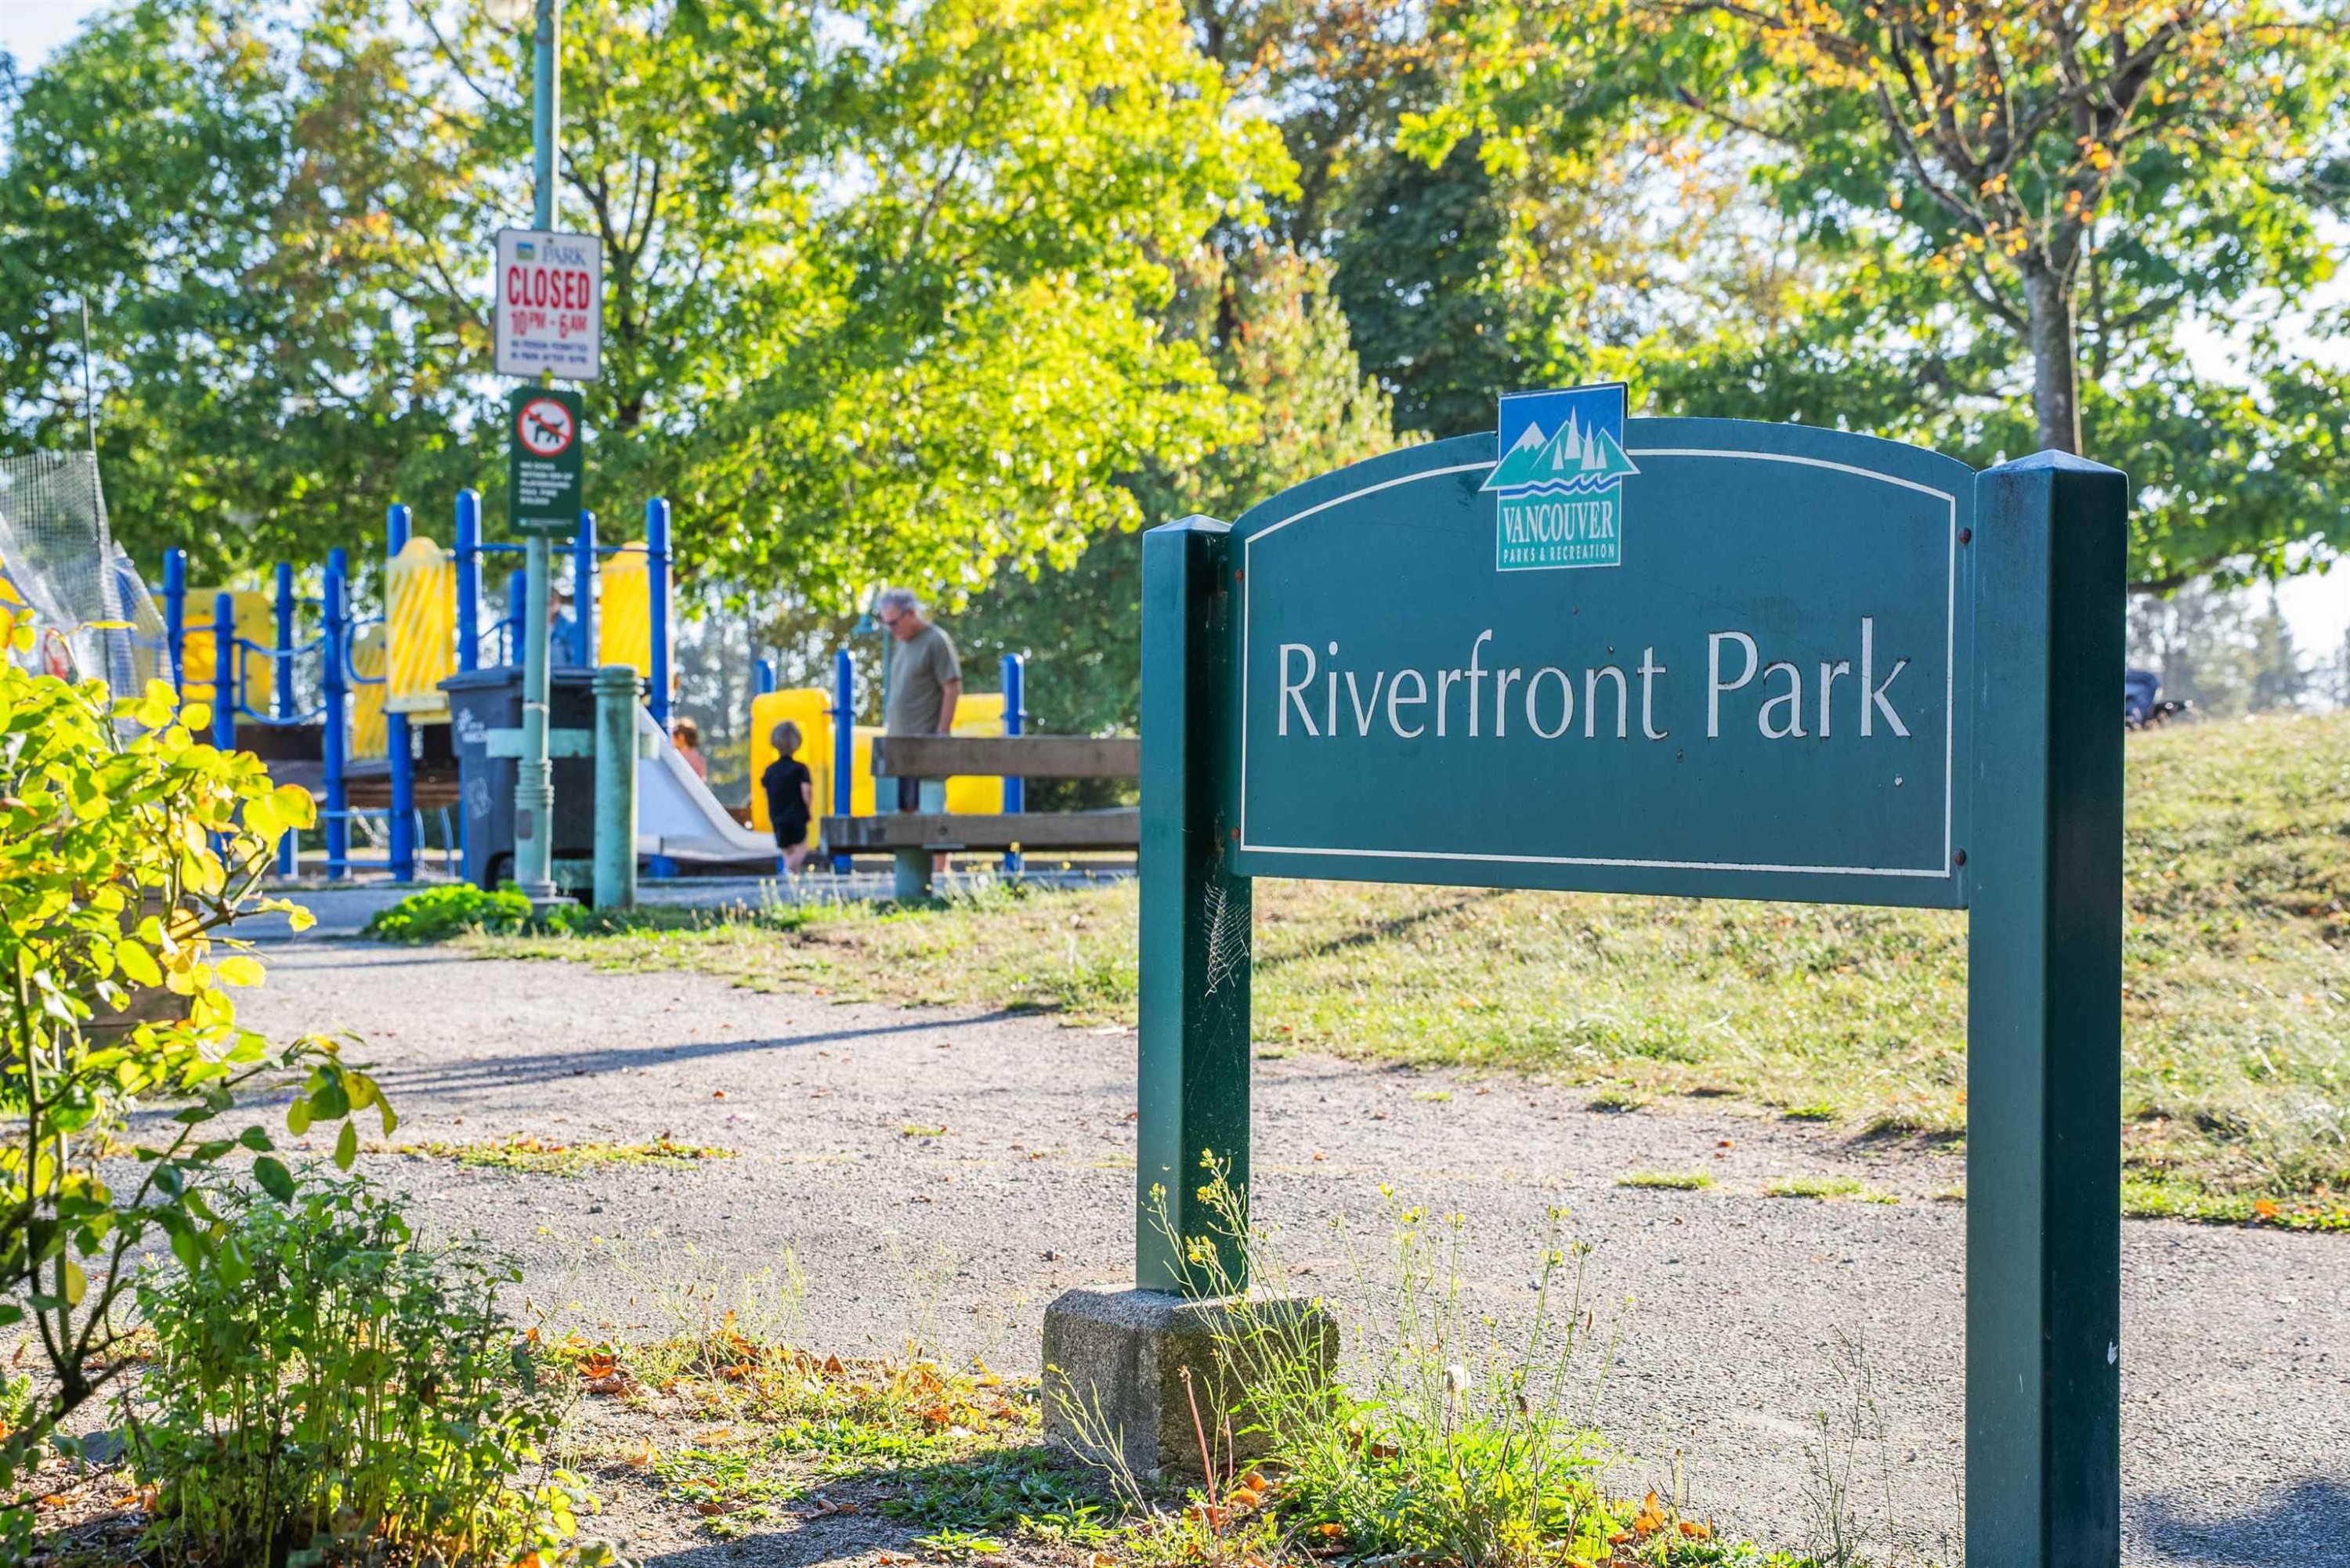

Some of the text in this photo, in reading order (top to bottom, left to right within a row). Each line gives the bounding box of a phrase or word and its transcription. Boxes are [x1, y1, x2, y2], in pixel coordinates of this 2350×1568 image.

[542, 244, 586, 266] PARK
[508, 266, 590, 310] CLOSED
[1502, 500, 1615, 544] VANCOUVER
[1503, 544, 1614, 563] PARKS & RECREATION
[1278, 616, 1912, 742] Riverfront Park
